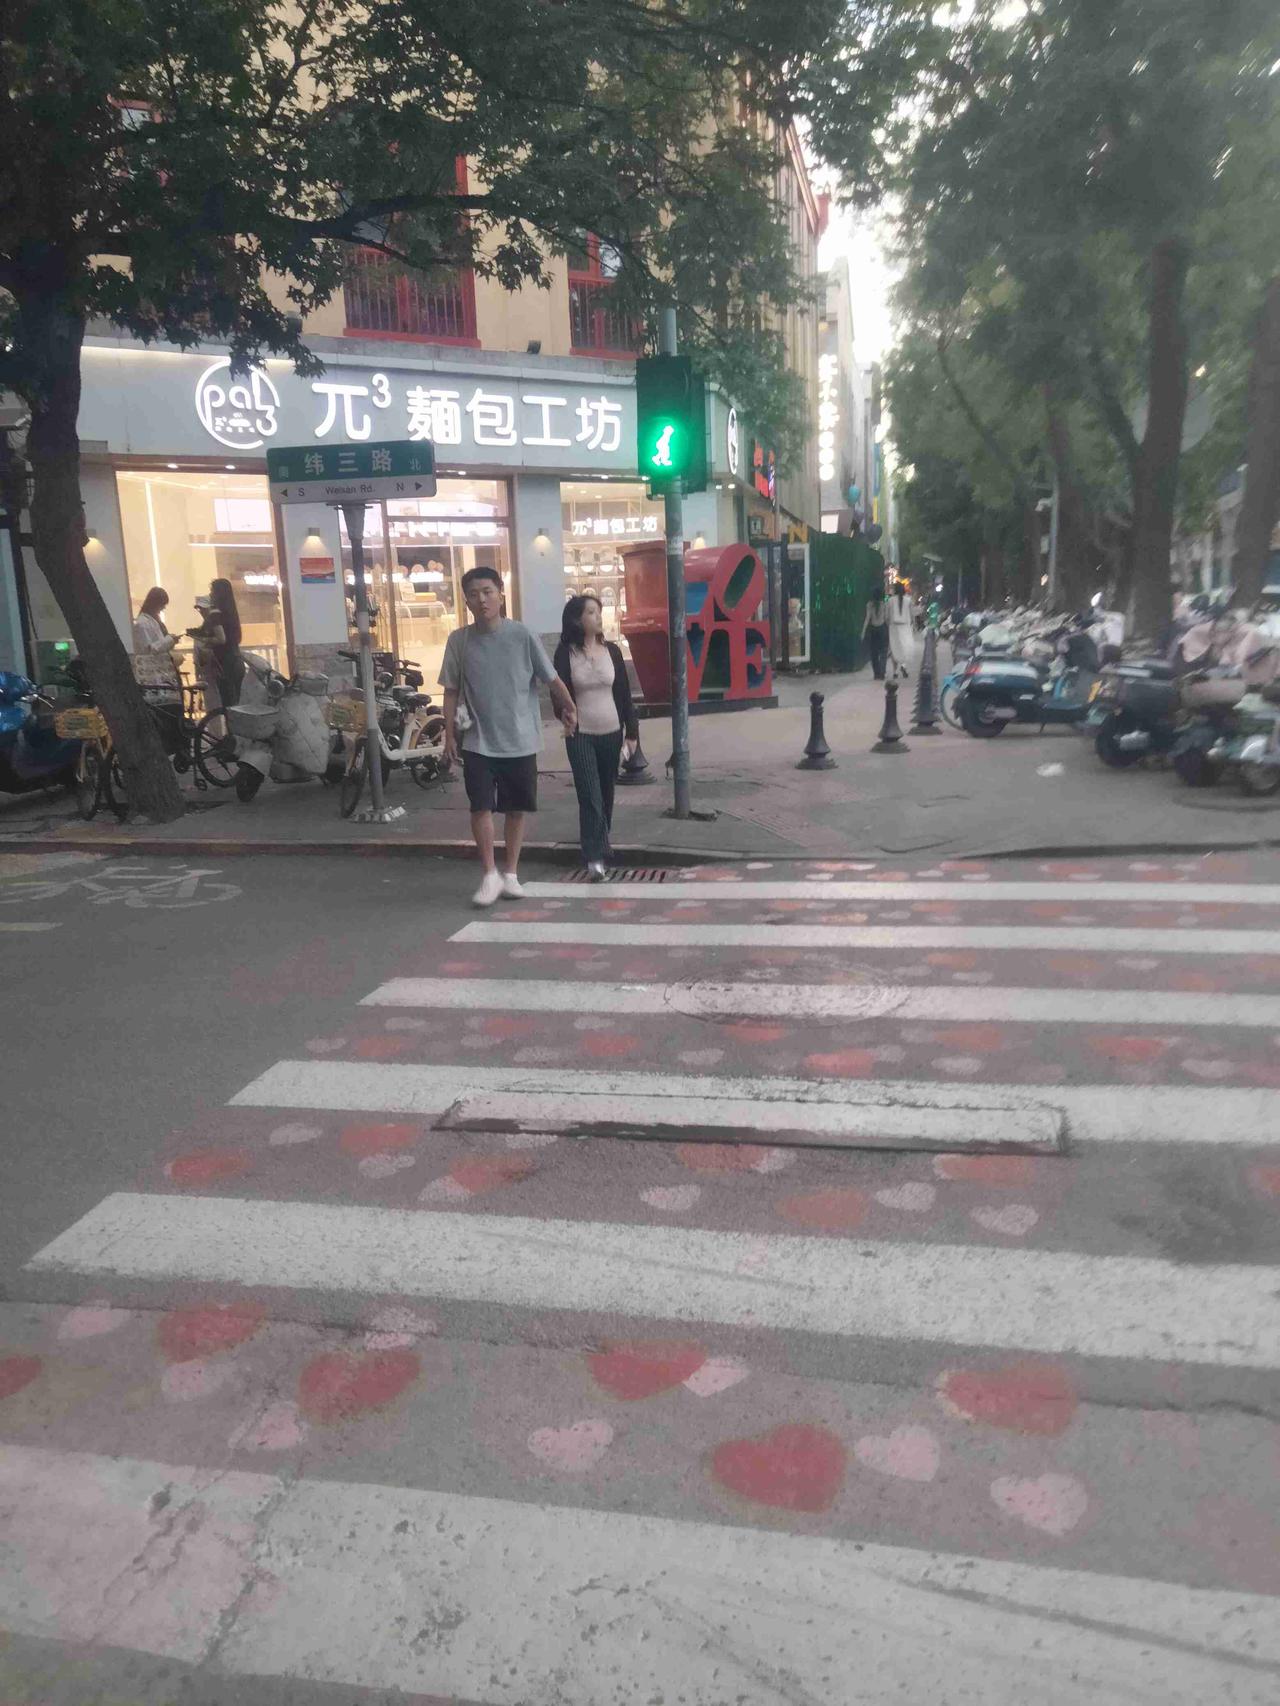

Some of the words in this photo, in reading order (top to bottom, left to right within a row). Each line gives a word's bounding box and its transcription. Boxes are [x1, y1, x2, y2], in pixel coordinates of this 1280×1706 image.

[304, 448, 392, 475] 纬三路
[409, 457, 422, 472] 北
[298, 487, 305, 497] S
[325, 485, 357, 496] Weisan
[396, 482, 405, 491] N
